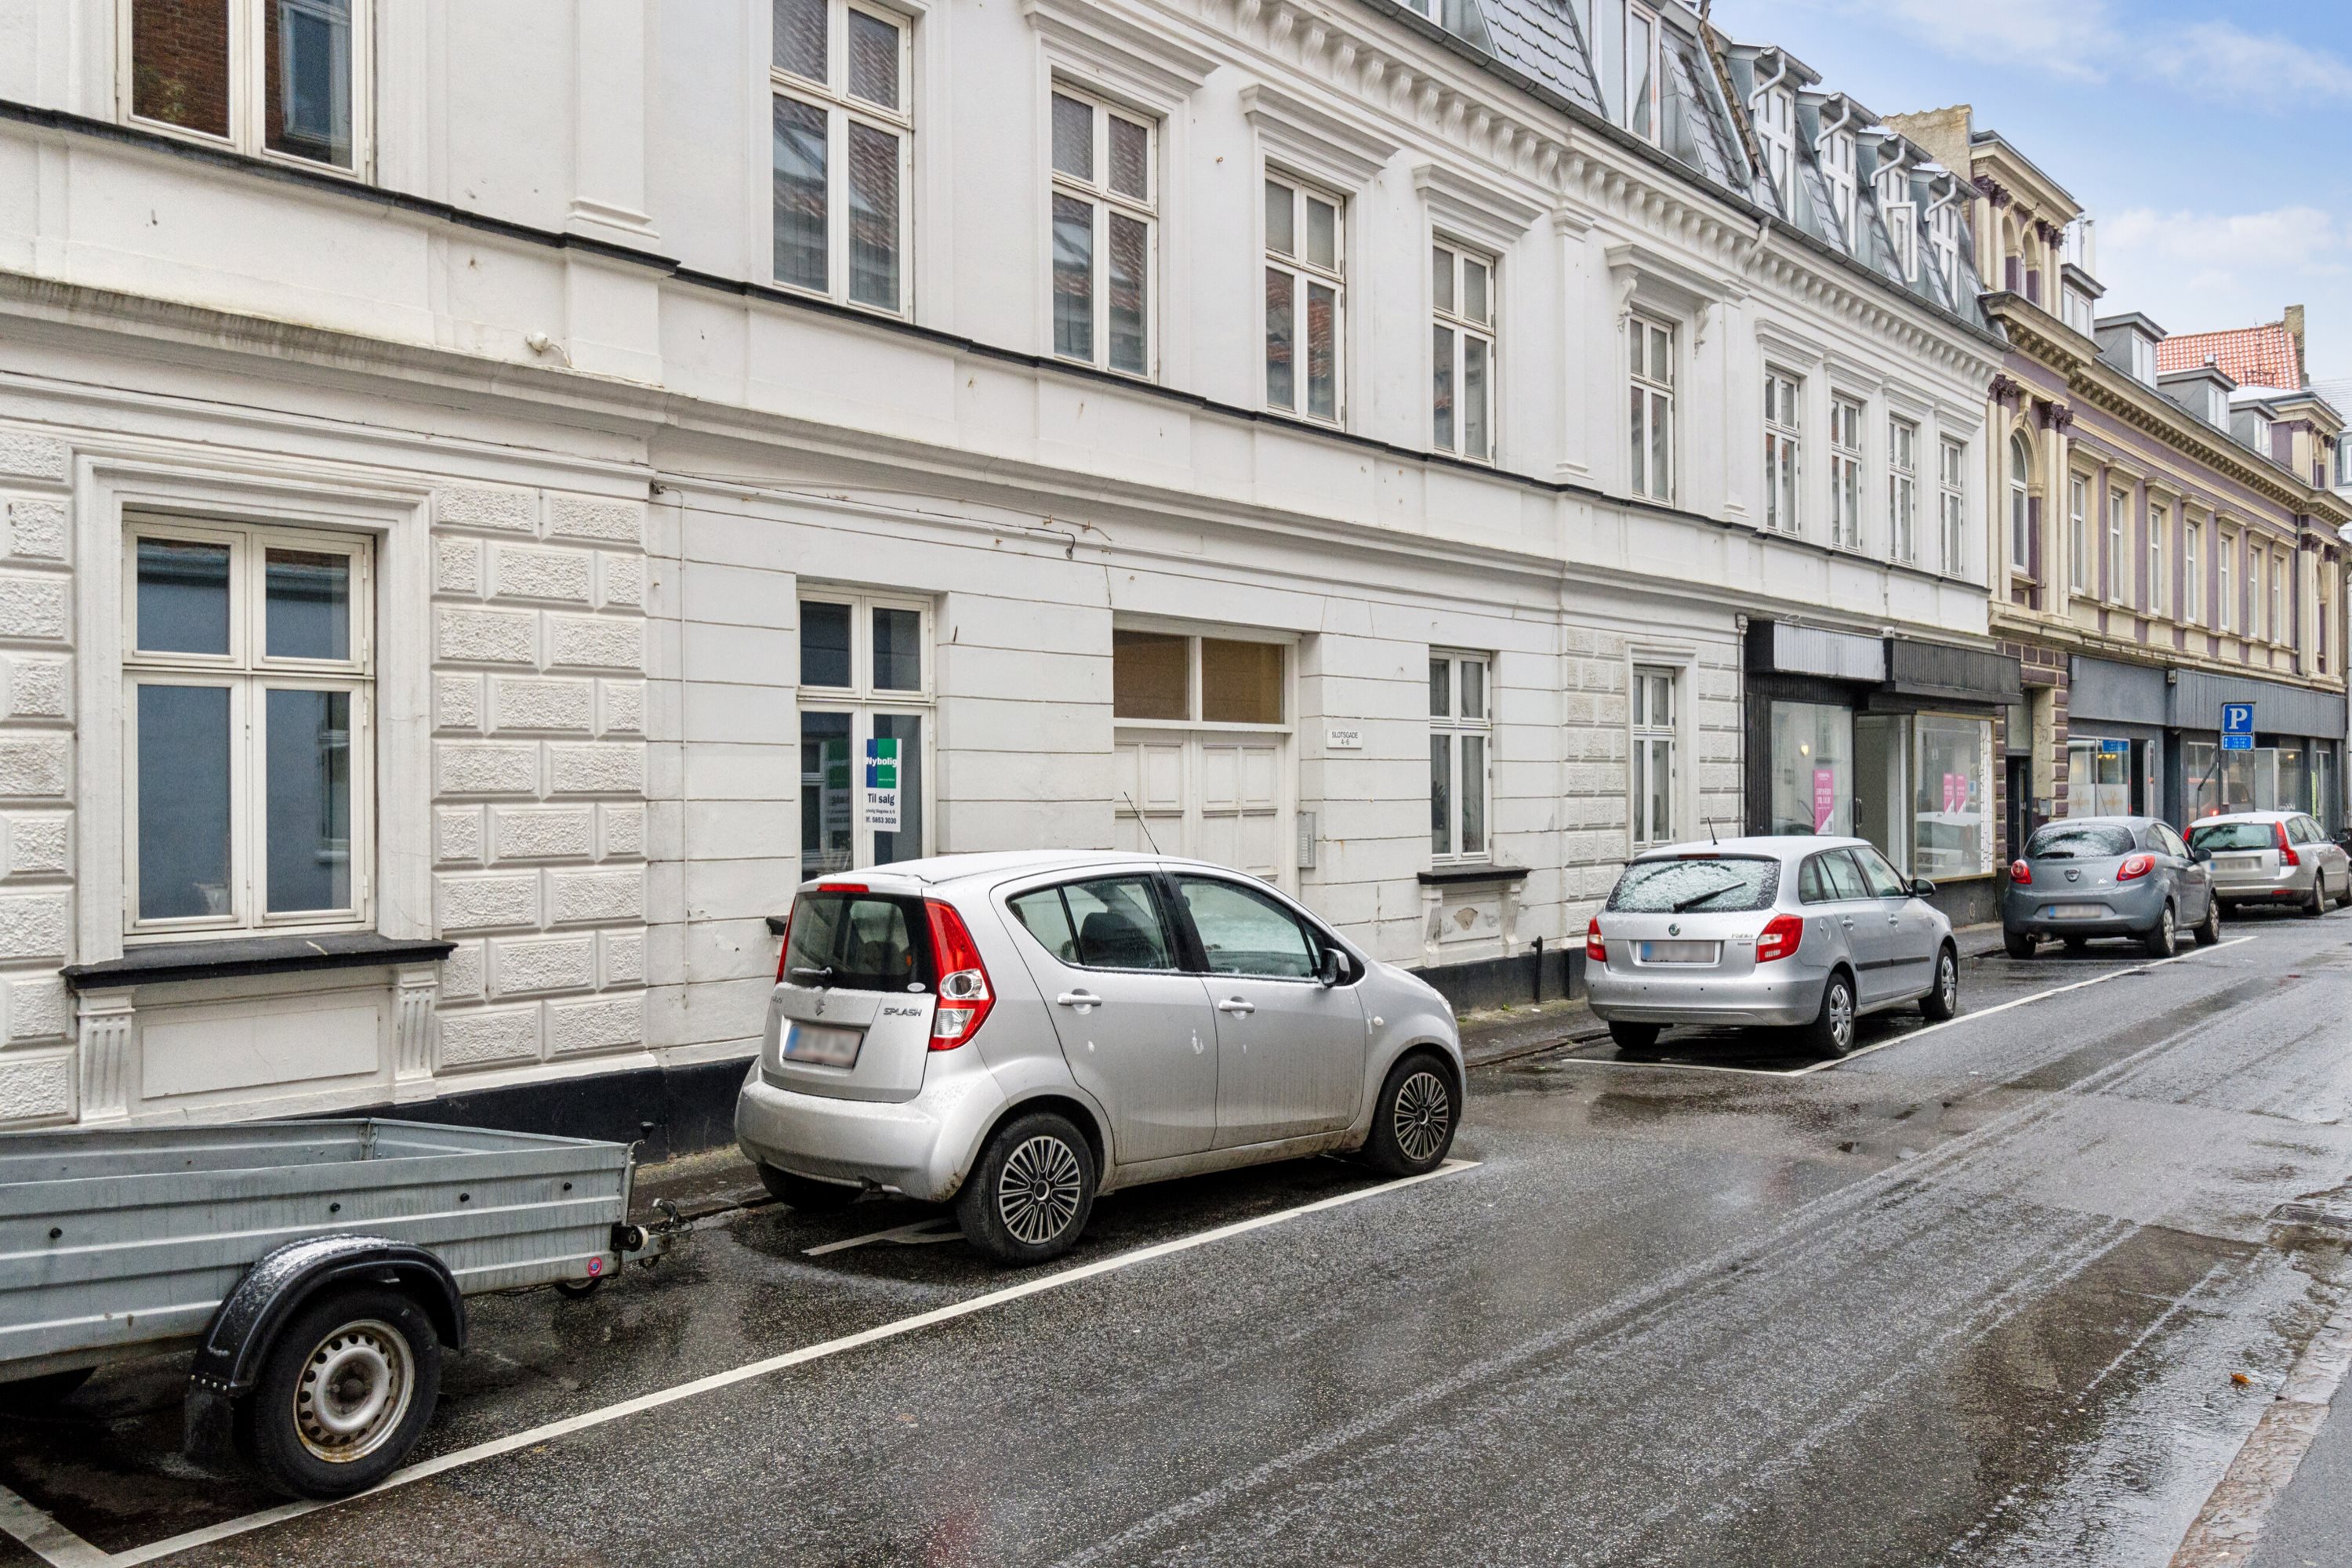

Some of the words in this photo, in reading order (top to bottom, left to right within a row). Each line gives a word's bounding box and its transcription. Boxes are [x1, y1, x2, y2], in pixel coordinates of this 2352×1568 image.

[2228, 707, 2248, 729] P
[866, 757, 897, 768] Nybolig
[868, 793, 877, 803] Til
[878, 793, 895, 806] salg
[883, 1007, 923, 1017] SPLASH
